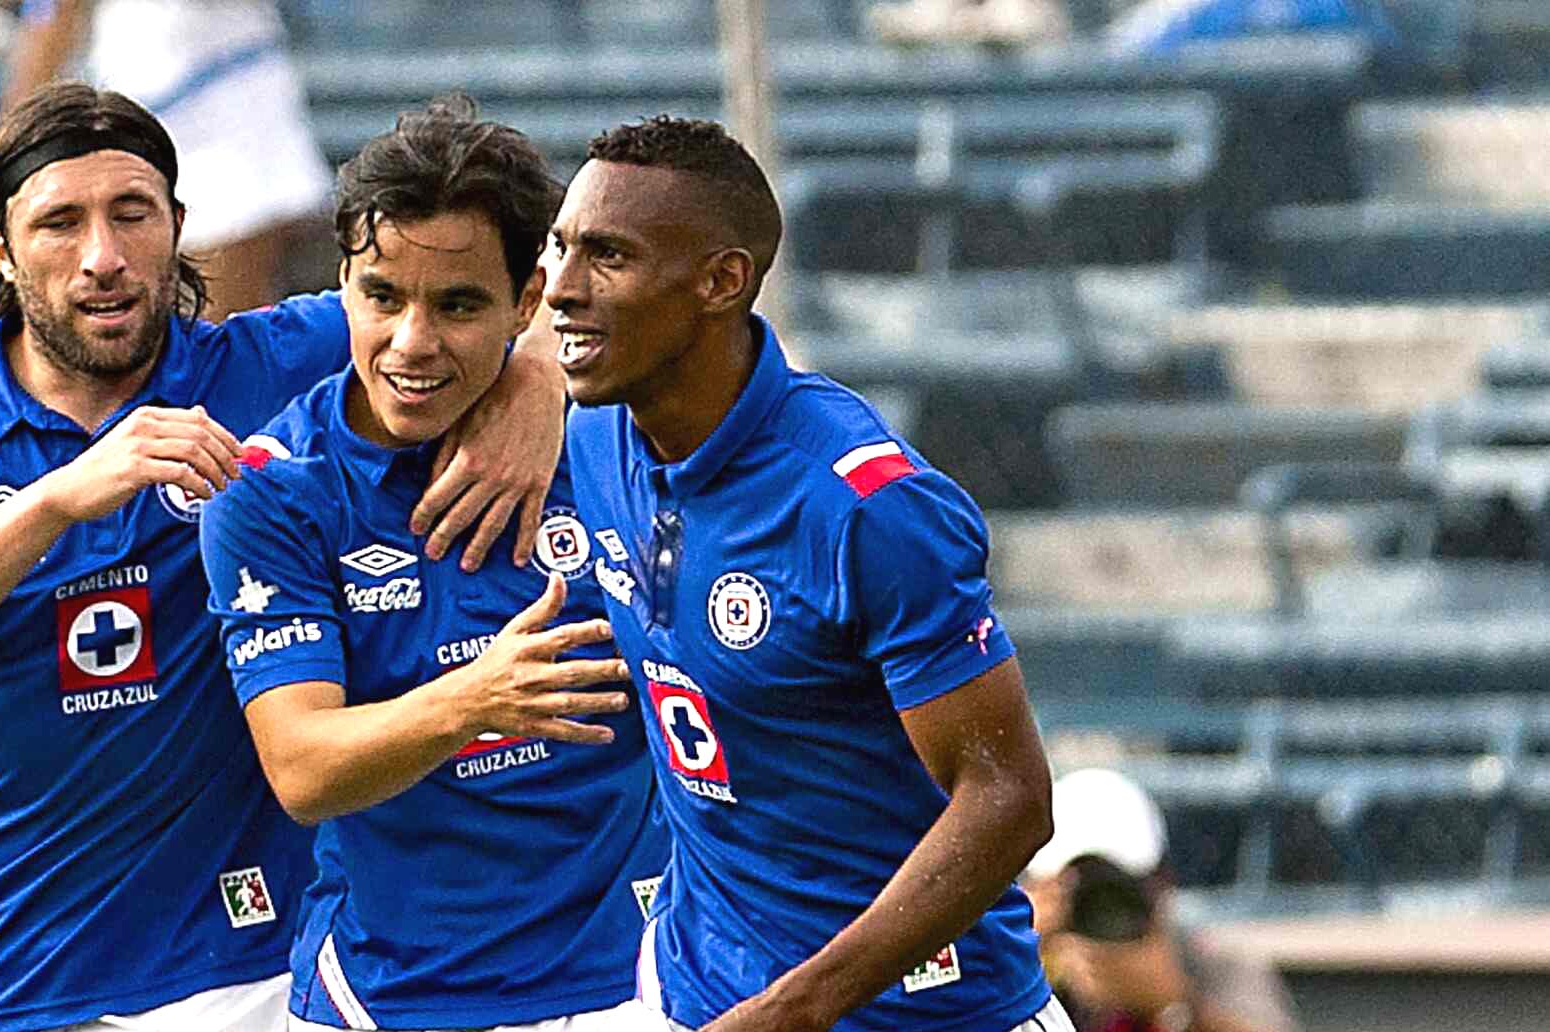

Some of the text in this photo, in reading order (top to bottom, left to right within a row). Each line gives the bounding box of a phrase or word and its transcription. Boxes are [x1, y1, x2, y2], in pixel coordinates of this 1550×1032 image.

[55, 565, 149, 600] CEMENTO
[234, 617, 322, 666] volaris
[437, 633, 498, 665] CEME
[62, 683, 159, 715] CRUZAZUL
[456, 742, 550, 779] CRUZAZUL
